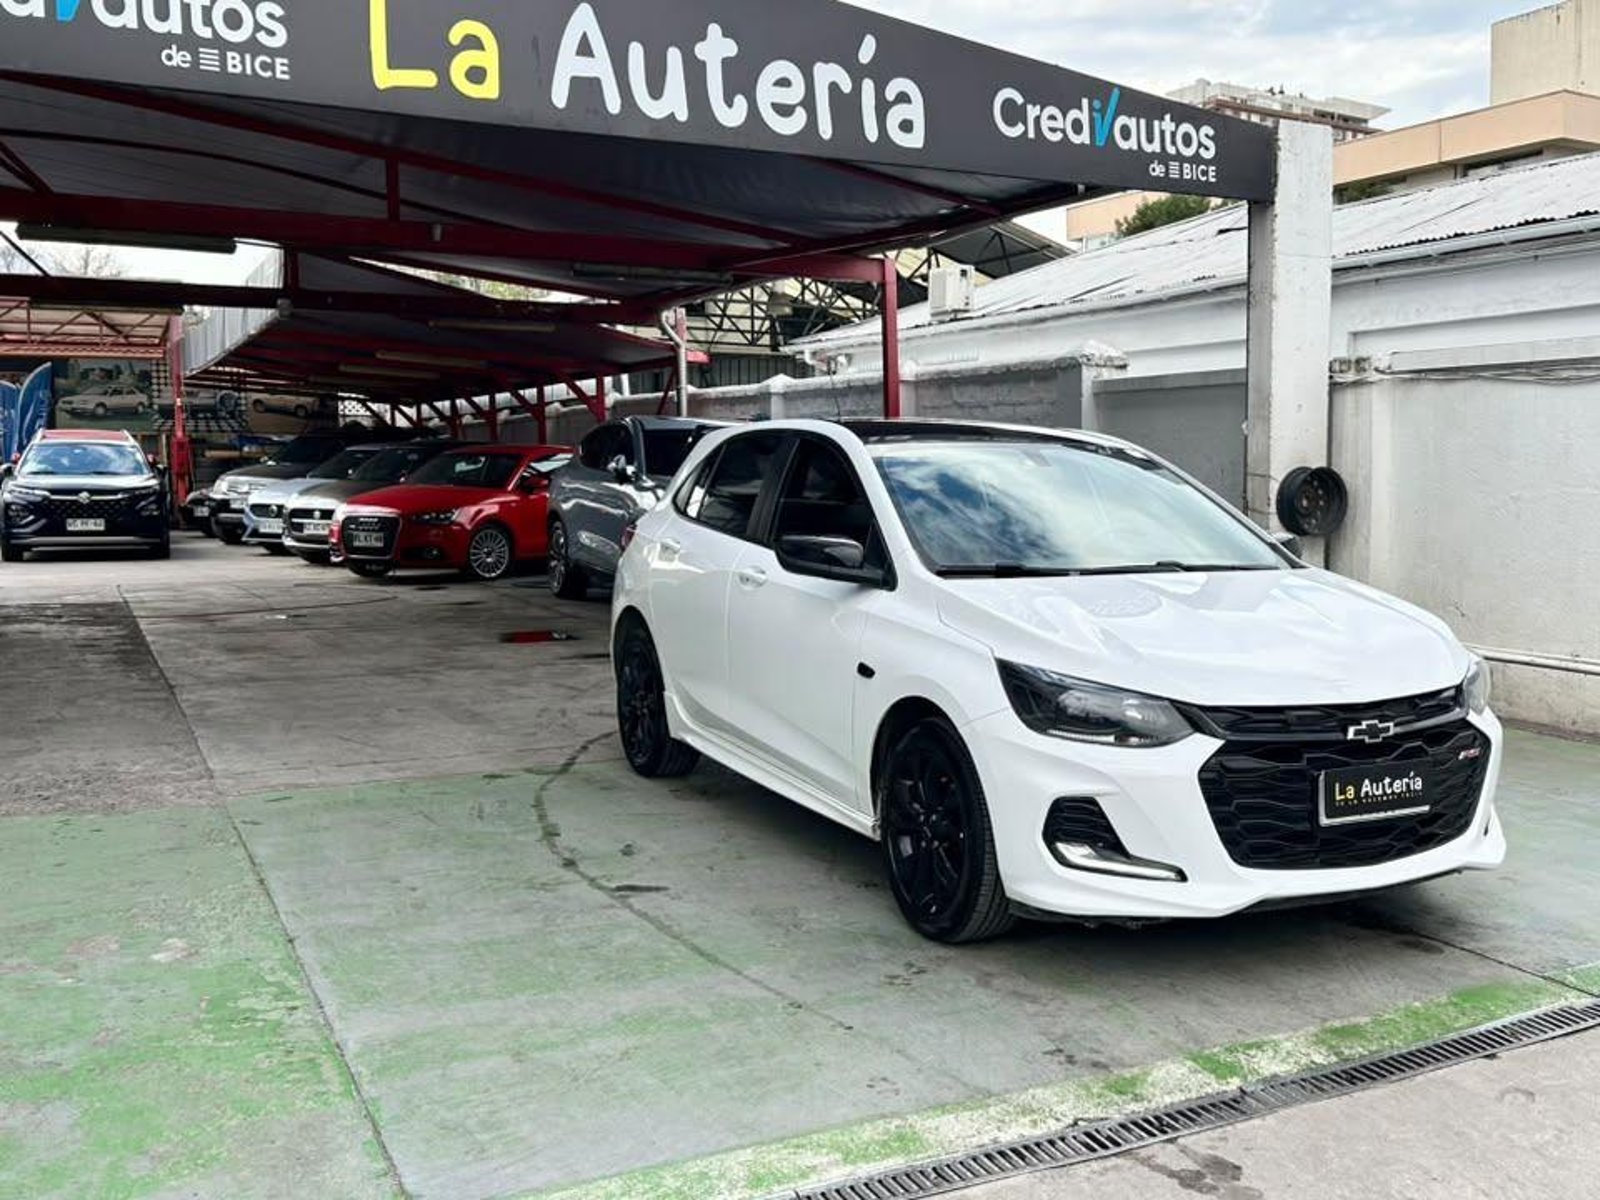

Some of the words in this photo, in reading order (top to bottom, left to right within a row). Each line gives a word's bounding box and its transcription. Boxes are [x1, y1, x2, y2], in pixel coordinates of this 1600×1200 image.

[161, 45, 192, 68] de
[227, 52, 290, 80] BICE
[370, 0, 499, 99] La
[551, 2, 925, 148] Autería
[1149, 160, 1166, 178] de
[1183, 163, 1217, 182] BICE
[1335, 782, 1355, 801] La
[1360, 771, 1423, 798] Autería
